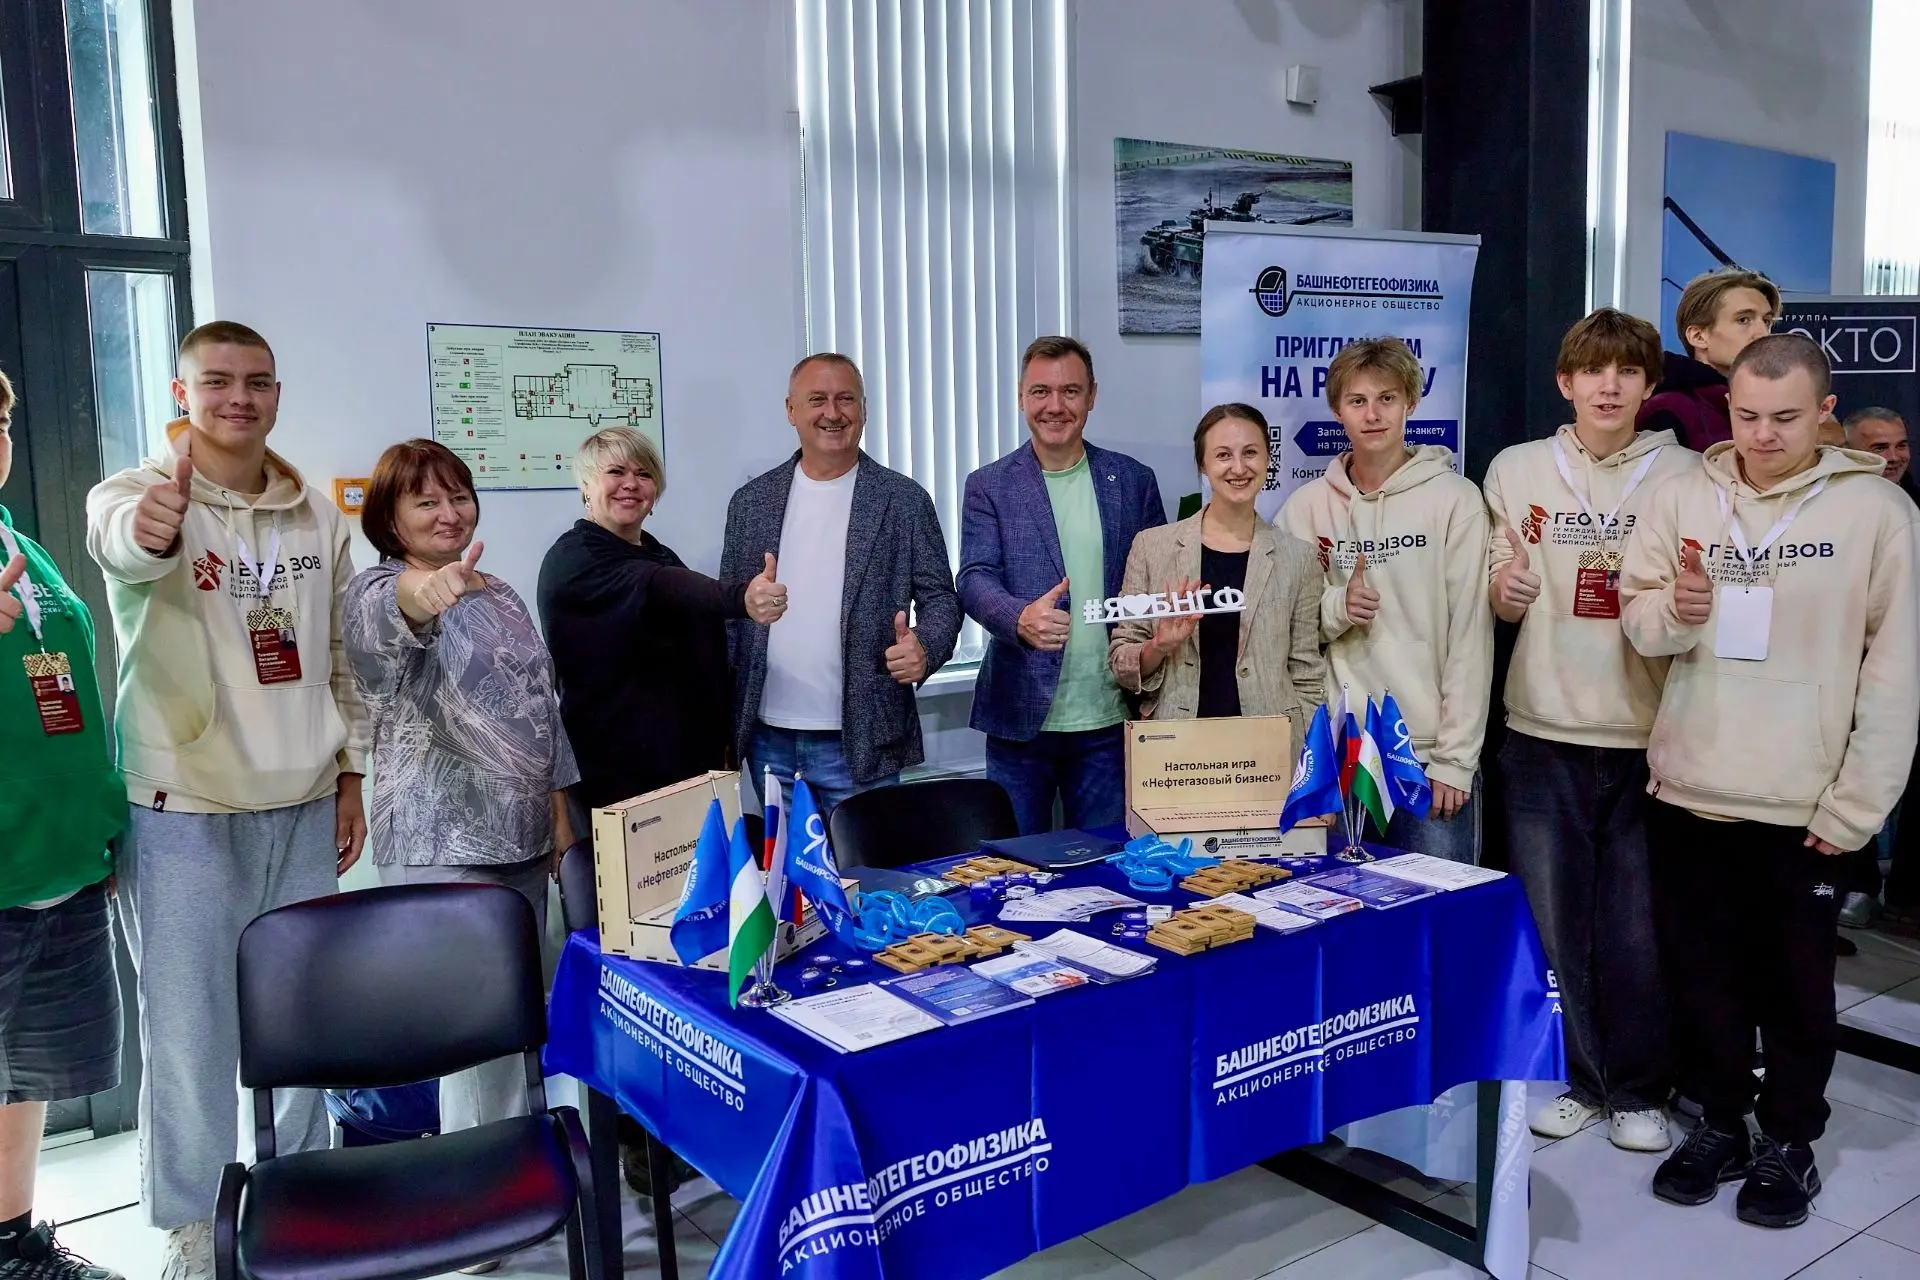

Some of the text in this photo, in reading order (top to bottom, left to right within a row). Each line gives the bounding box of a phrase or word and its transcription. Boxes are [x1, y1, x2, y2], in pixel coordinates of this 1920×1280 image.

[1296, 274, 1440, 293] БАШНЕФТЕГЕОФИЗИКА
[1296, 298, 1441, 311] АКЦИОНЕРНОЕ ОБЩЕСТВО
[1785, 314, 1828, 322] ГРУППА
[1275, 335, 1422, 359] ПРИГЛМ
[1262, 365, 1303, 398] НА
[1317, 442, 1332, 450] на
[1165, 759, 1257, 772] Настольная игра
[1141, 773, 1281, 789] «Нефтегазовый бизнес»
[600, 964, 743, 1080] БАШНЕФТЕГЕОФИЗИКА
[1216, 994, 1416, 1077] БАШНЕФТЕГЕОФИЗИКА
[600, 1002, 744, 1112] АКЦИОНЕРНОЕ ОБЩЕСТВО
[1216, 1027, 1416, 1106] АКЦИОНЕРНОЕ ОБЩЕСТВО
[778, 1117, 1047, 1248] БАШНЕФТЕГЕОФИЗИКА
[781, 1157, 1050, 1276] АКЦИОНЕРНОЕ ОБЩЕСТВО
